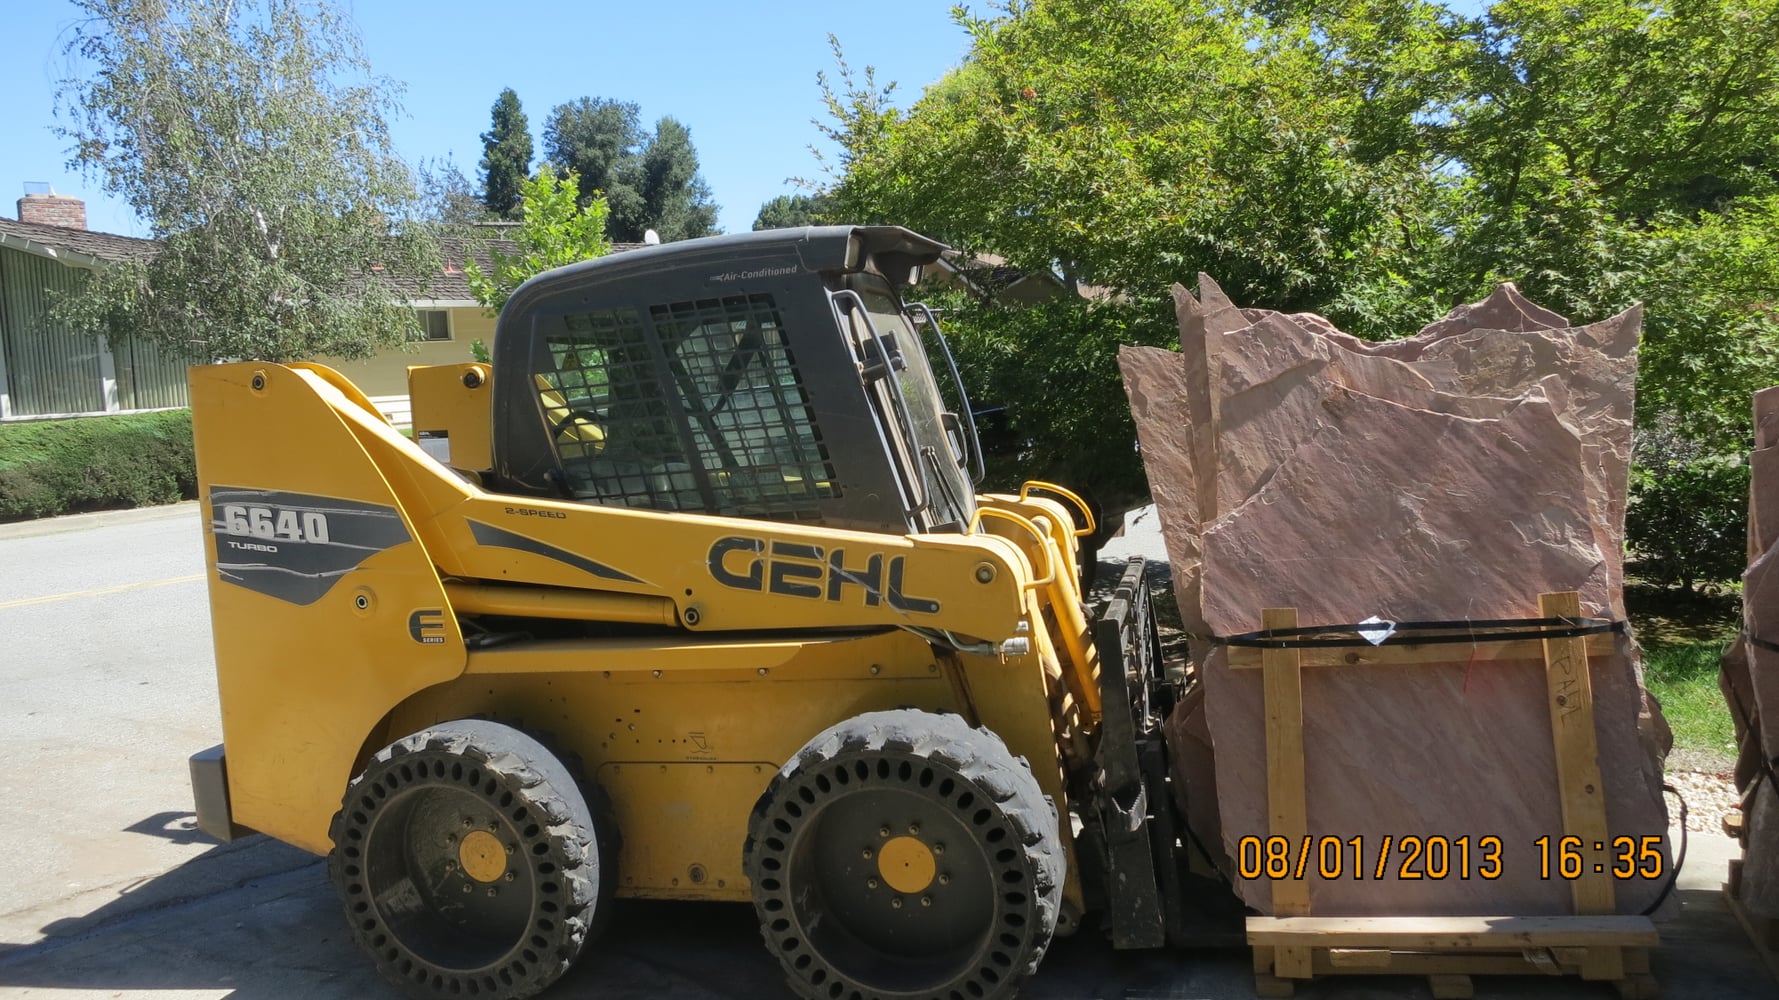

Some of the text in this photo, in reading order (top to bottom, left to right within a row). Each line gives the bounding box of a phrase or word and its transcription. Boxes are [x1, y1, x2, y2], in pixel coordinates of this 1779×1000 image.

[724, 264, 798, 281] Air-Conditioned
[505, 507, 567, 519] 2-SPEED
[224, 505, 330, 544] 6640
[227, 541, 278, 553] TURBO
[708, 536, 940, 614] GEHL
